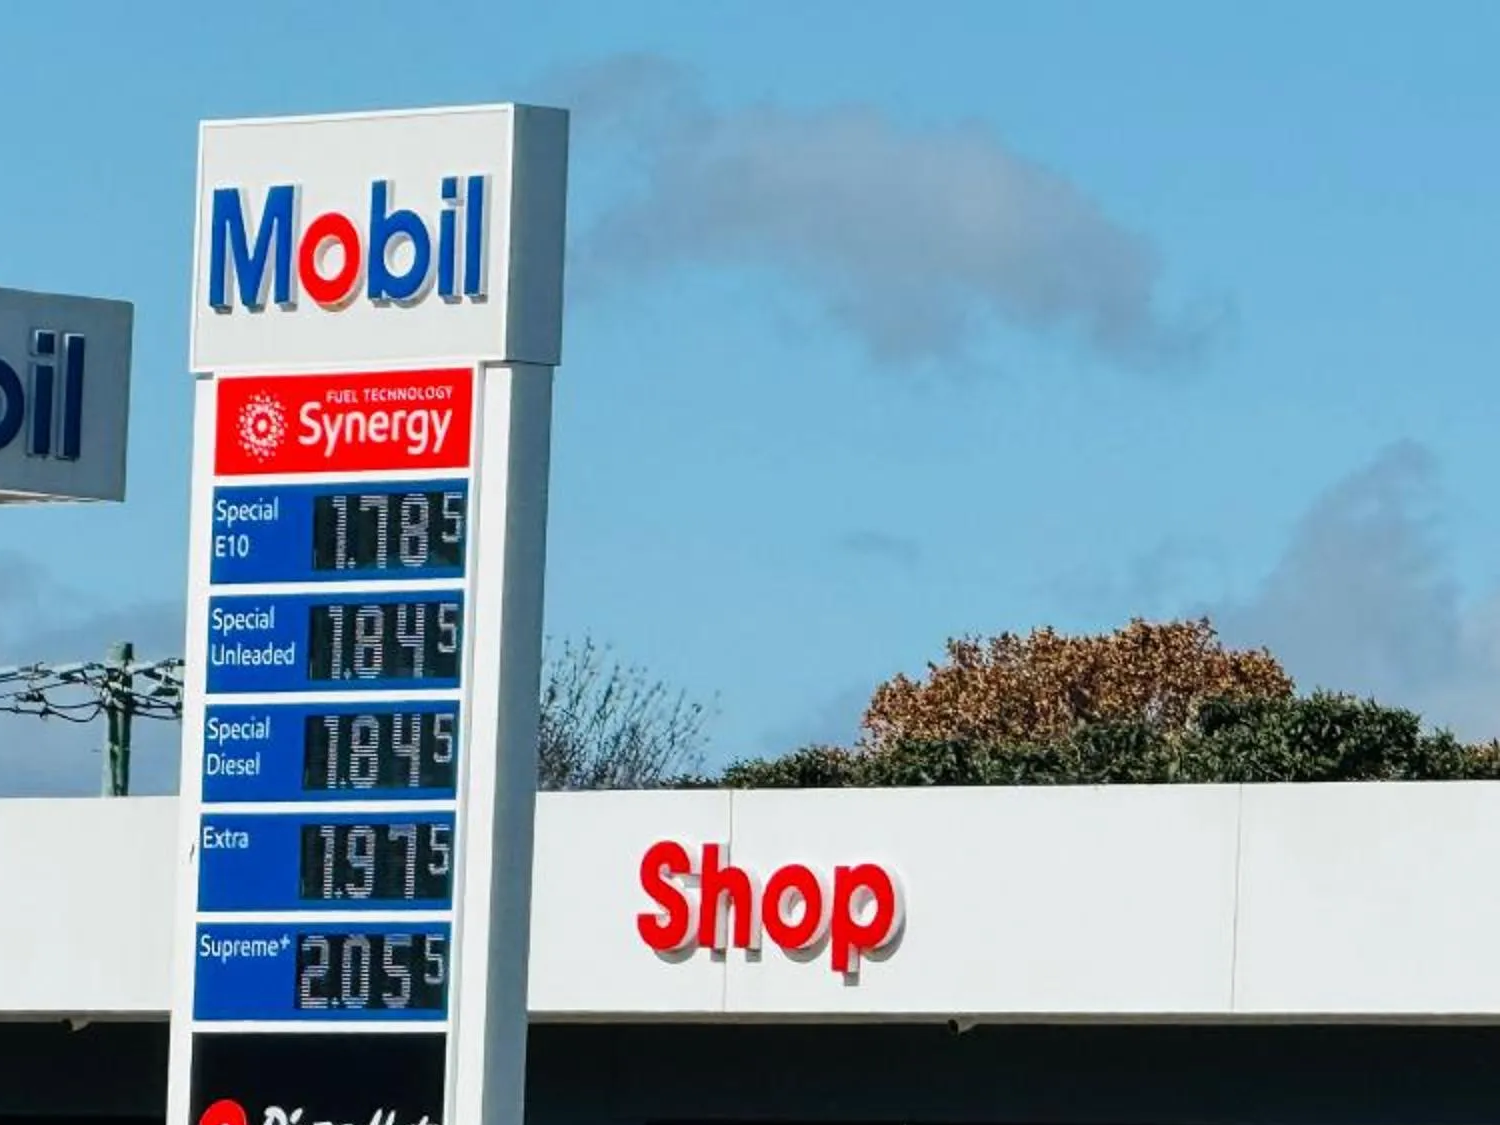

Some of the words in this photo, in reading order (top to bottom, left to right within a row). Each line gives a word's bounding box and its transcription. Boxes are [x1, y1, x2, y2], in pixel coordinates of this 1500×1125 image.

[209, 174, 490, 313] Mobil
[326, 389, 358, 404] FUEL
[364, 385, 453, 402] TECHNOLOGY
[299, 401, 453, 458] Synergy
[215, 497, 279, 528] Special
[215, 534, 249, 558] E10
[211, 605, 275, 635] Special
[211, 642, 295, 666] Unleaded
[207, 715, 271, 747] Special
[206, 751, 261, 776] Diesel
[203, 826, 250, 849] Extra
[637, 840, 902, 978] Shop
